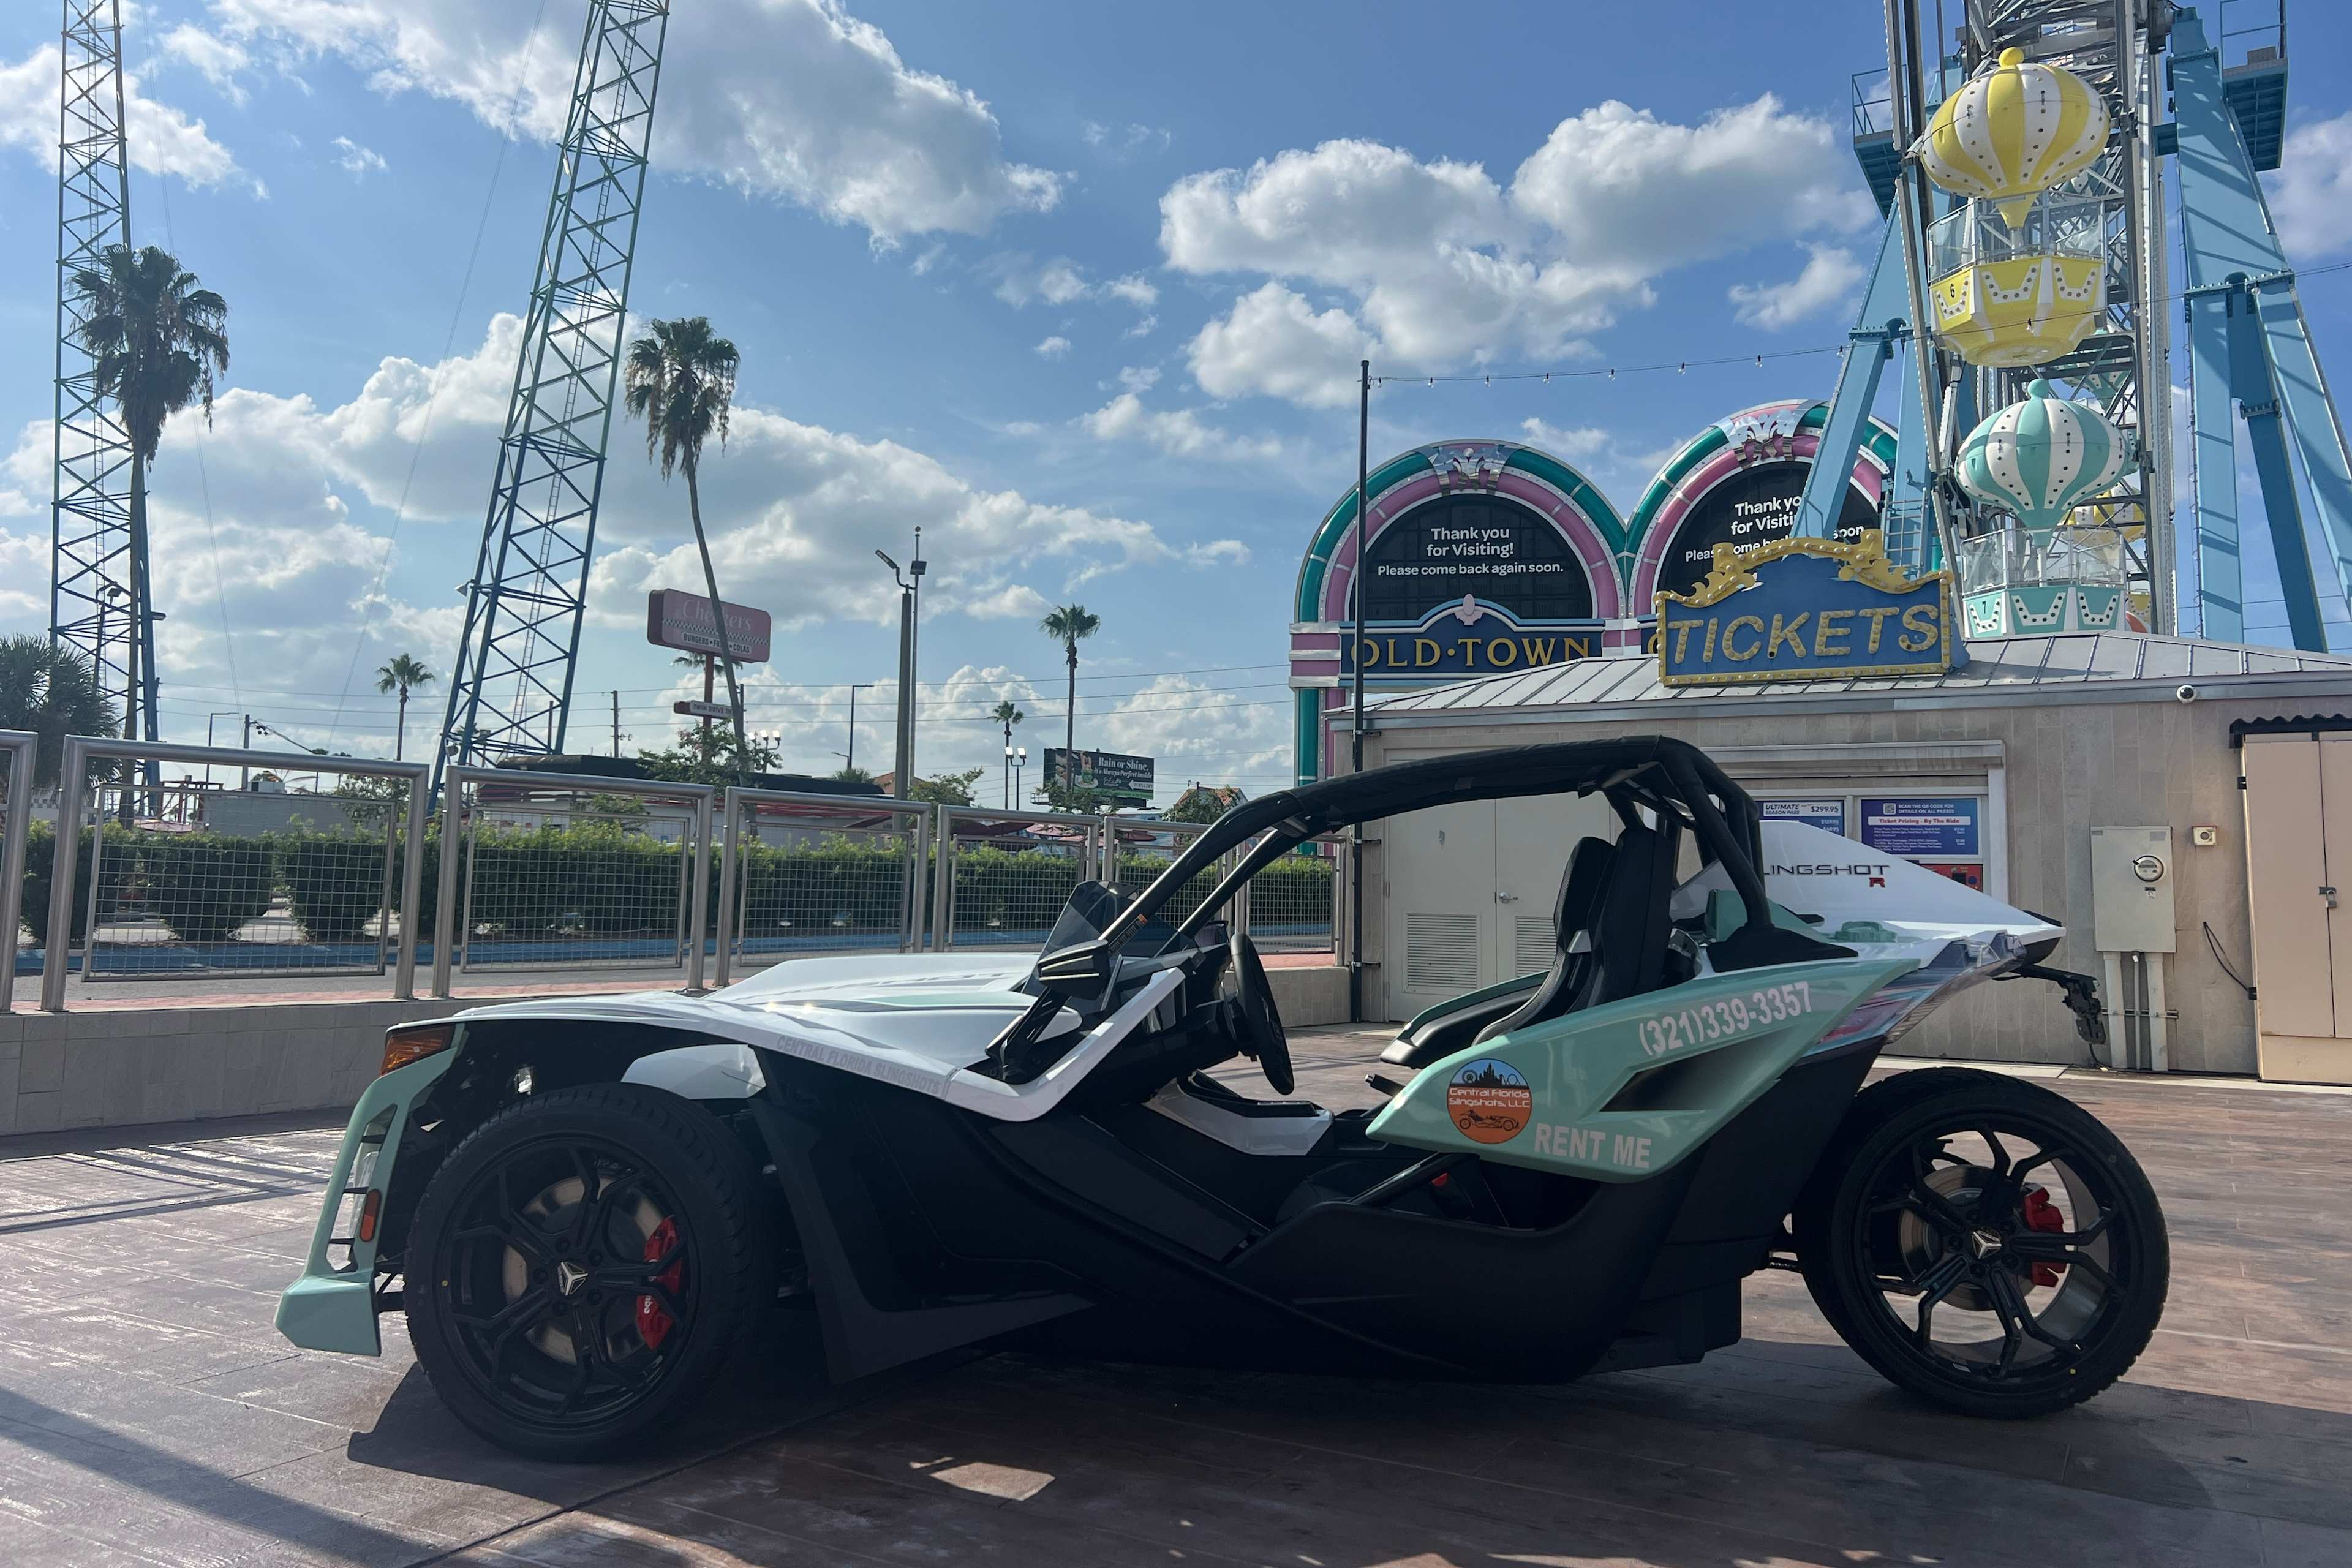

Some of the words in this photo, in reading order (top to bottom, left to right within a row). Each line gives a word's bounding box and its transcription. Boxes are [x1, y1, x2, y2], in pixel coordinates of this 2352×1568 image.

[1950, 284, 1955, 298] 6
[1735, 497, 1781, 516] Thank
[1784, 496, 1802, 511] yo
[1731, 521, 1753, 535] for
[1755, 511, 1793, 530] Visiti
[1431, 527, 1479, 540] Thank
[1481, 528, 1510, 541] you
[1427, 544, 1449, 556] for
[1452, 543, 1514, 558] Visiting!
[1686, 549, 1714, 562] Pleas
[1733, 543, 1760, 554] ome
[1378, 564, 1419, 576] Please
[1421, 564, 1456, 575] come
[1459, 563, 1490, 575] back
[1491, 562, 1526, 576] again
[1528, 563, 1564, 573] soon.
[1982, 601, 1986, 614] 7
[684, 633, 709, 646] BURGERS
[1668, 604, 1939, 664] TICKETS
[708, 706, 723, 714] DRIVE
[1098, 757, 1116, 767] Rain
[1126, 760, 1149, 772] Shine,
[1103, 768, 1120, 777] Always
[1120, 770, 1137, 778] Perfect
[1869, 877, 1886, 888] R
[1639, 981, 1812, 1056] (321)339-3357
[777, 1035, 824, 1063] CENTRAL
[827, 1049, 872, 1077] FLORIDA
[874, 1063, 941, 1095] SLINGSHOTS
[1449, 1088, 1490, 1096] Central
[1449, 1098, 1506, 1107] Slingshots,
[1534, 1123, 1606, 1161] RENT
[1613, 1134, 1652, 1169] ME
